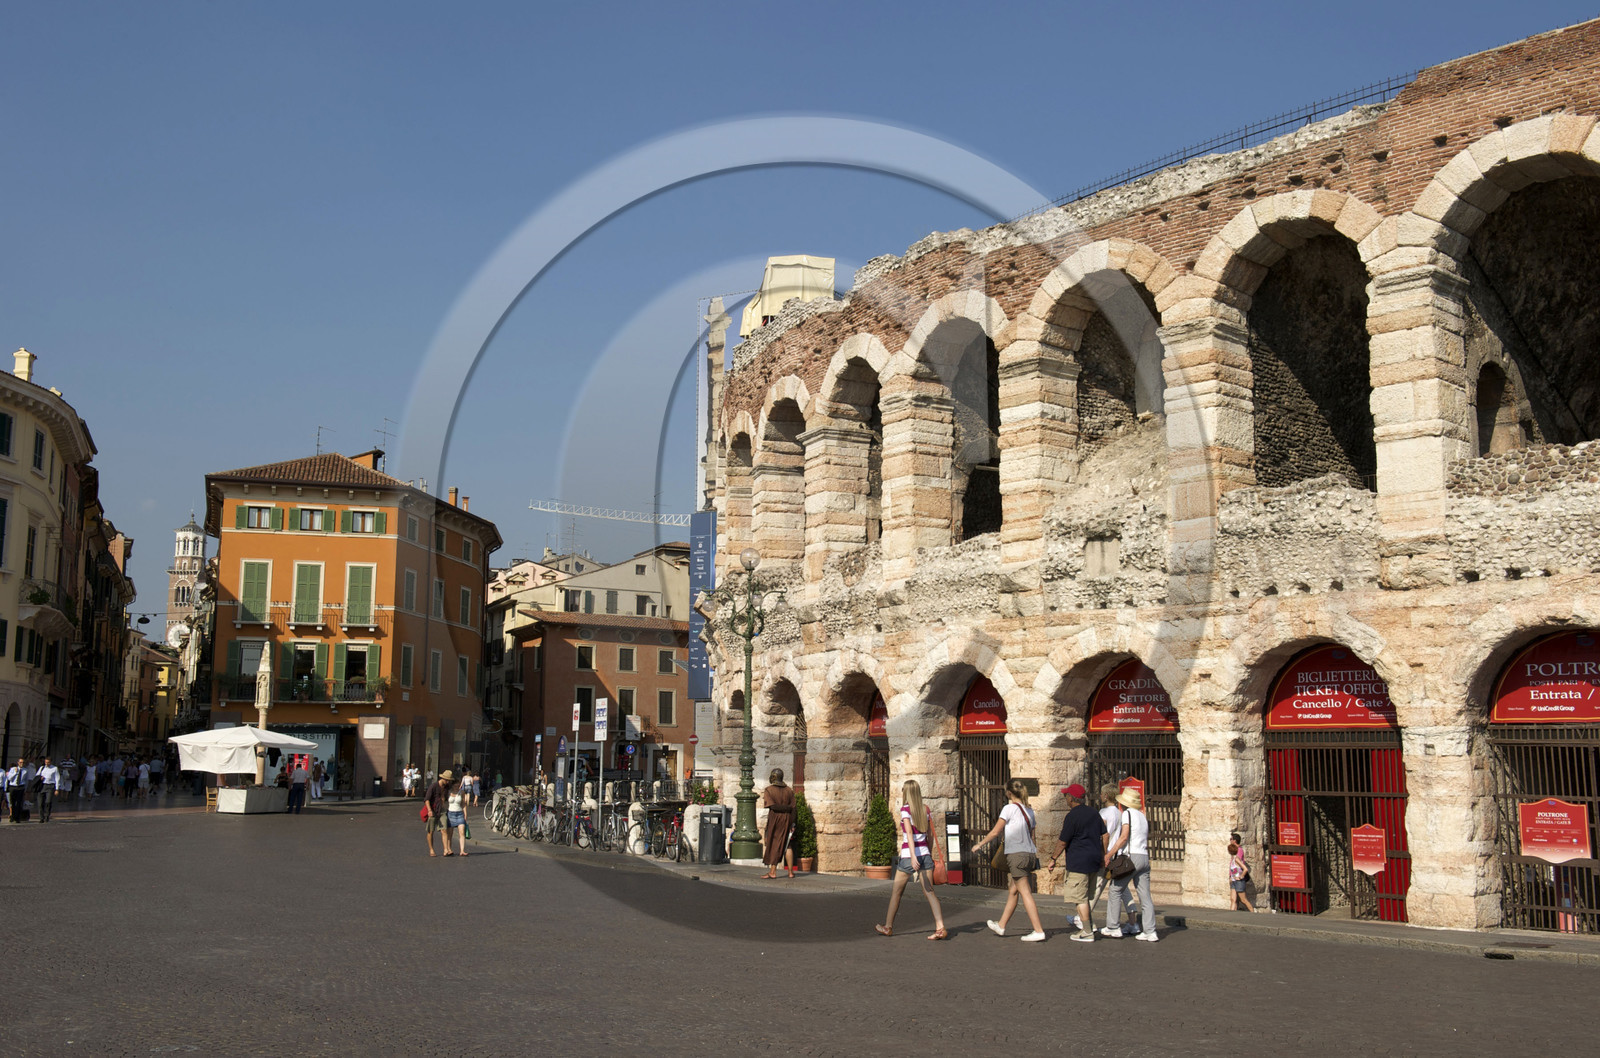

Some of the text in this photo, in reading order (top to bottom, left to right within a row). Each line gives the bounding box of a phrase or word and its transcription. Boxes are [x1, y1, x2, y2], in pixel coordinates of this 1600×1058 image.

[1526, 662, 1600, 676] POLTR
[1297, 671, 1379, 683] BIGLIETTERI
[1294, 683, 1389, 696] TICKET OFFICE
[1530, 689, 1582, 700] Entrata
[973, 699, 999, 708] Cancello
[1293, 698, 1342, 709] Cancello
[1355, 698, 1383, 708] Gate
[1113, 705, 1145, 714] Entrata
